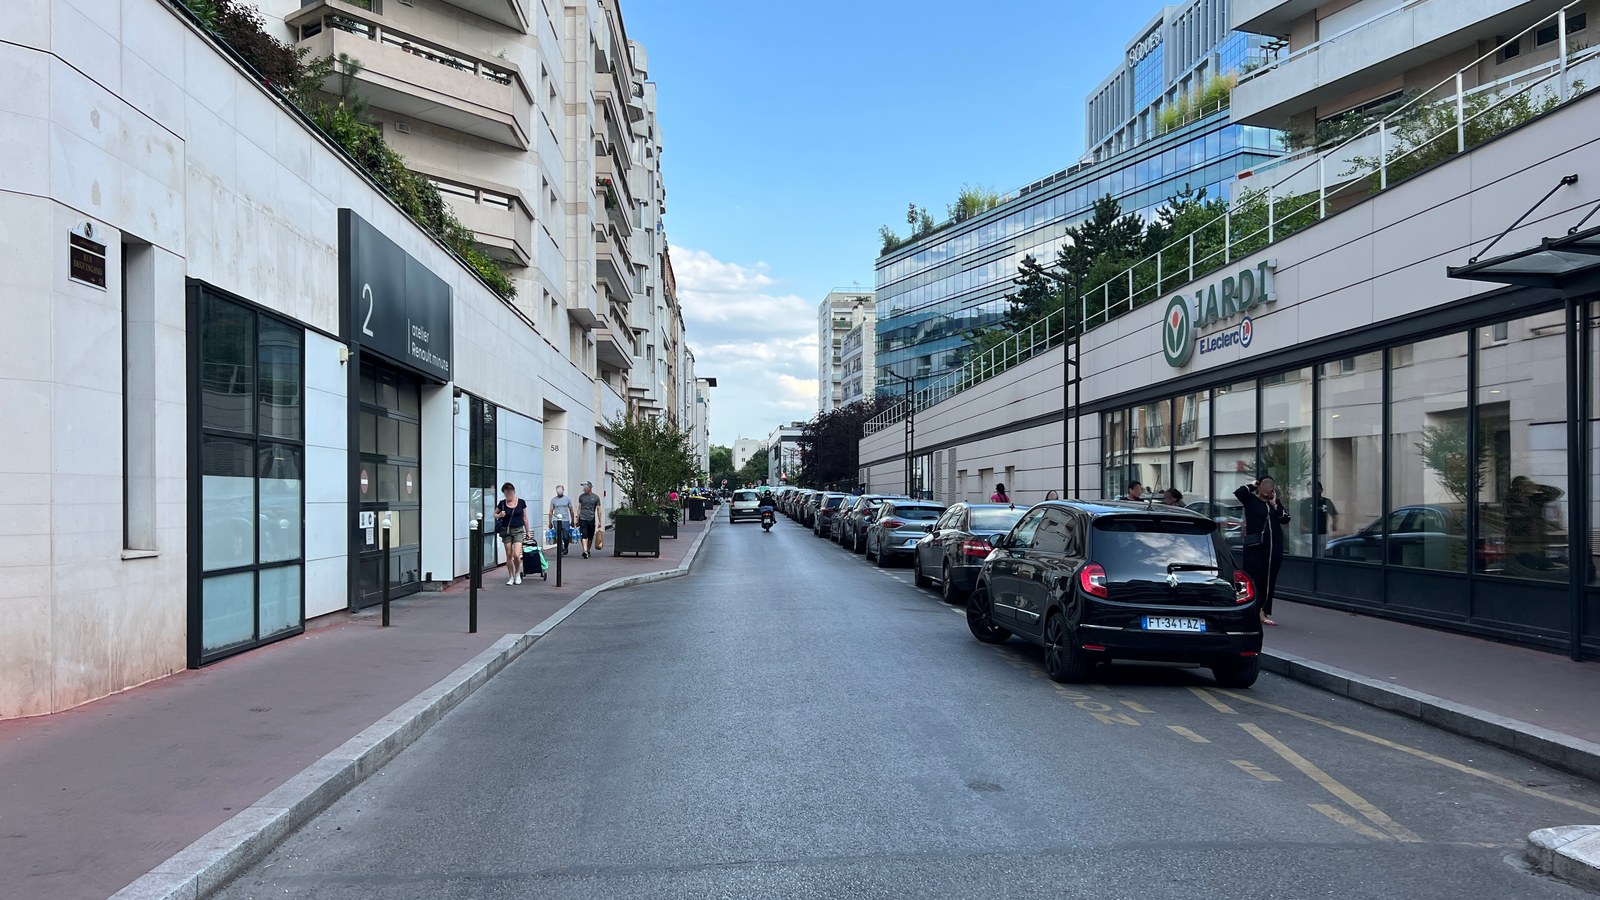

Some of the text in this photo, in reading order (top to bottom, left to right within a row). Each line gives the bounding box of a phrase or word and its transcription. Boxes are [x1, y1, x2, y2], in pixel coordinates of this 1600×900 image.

[1193, 259, 1269, 329] JARDI
[362, 282, 374, 338] 2
[411, 324, 430, 343] atelier
[1199, 331, 1240, 355] E.Leclerc
[411, 341, 449, 372] Renault minute
[550, 444, 560, 452] 58
[1148, 617, 1199, 630] FT-341-AZ
